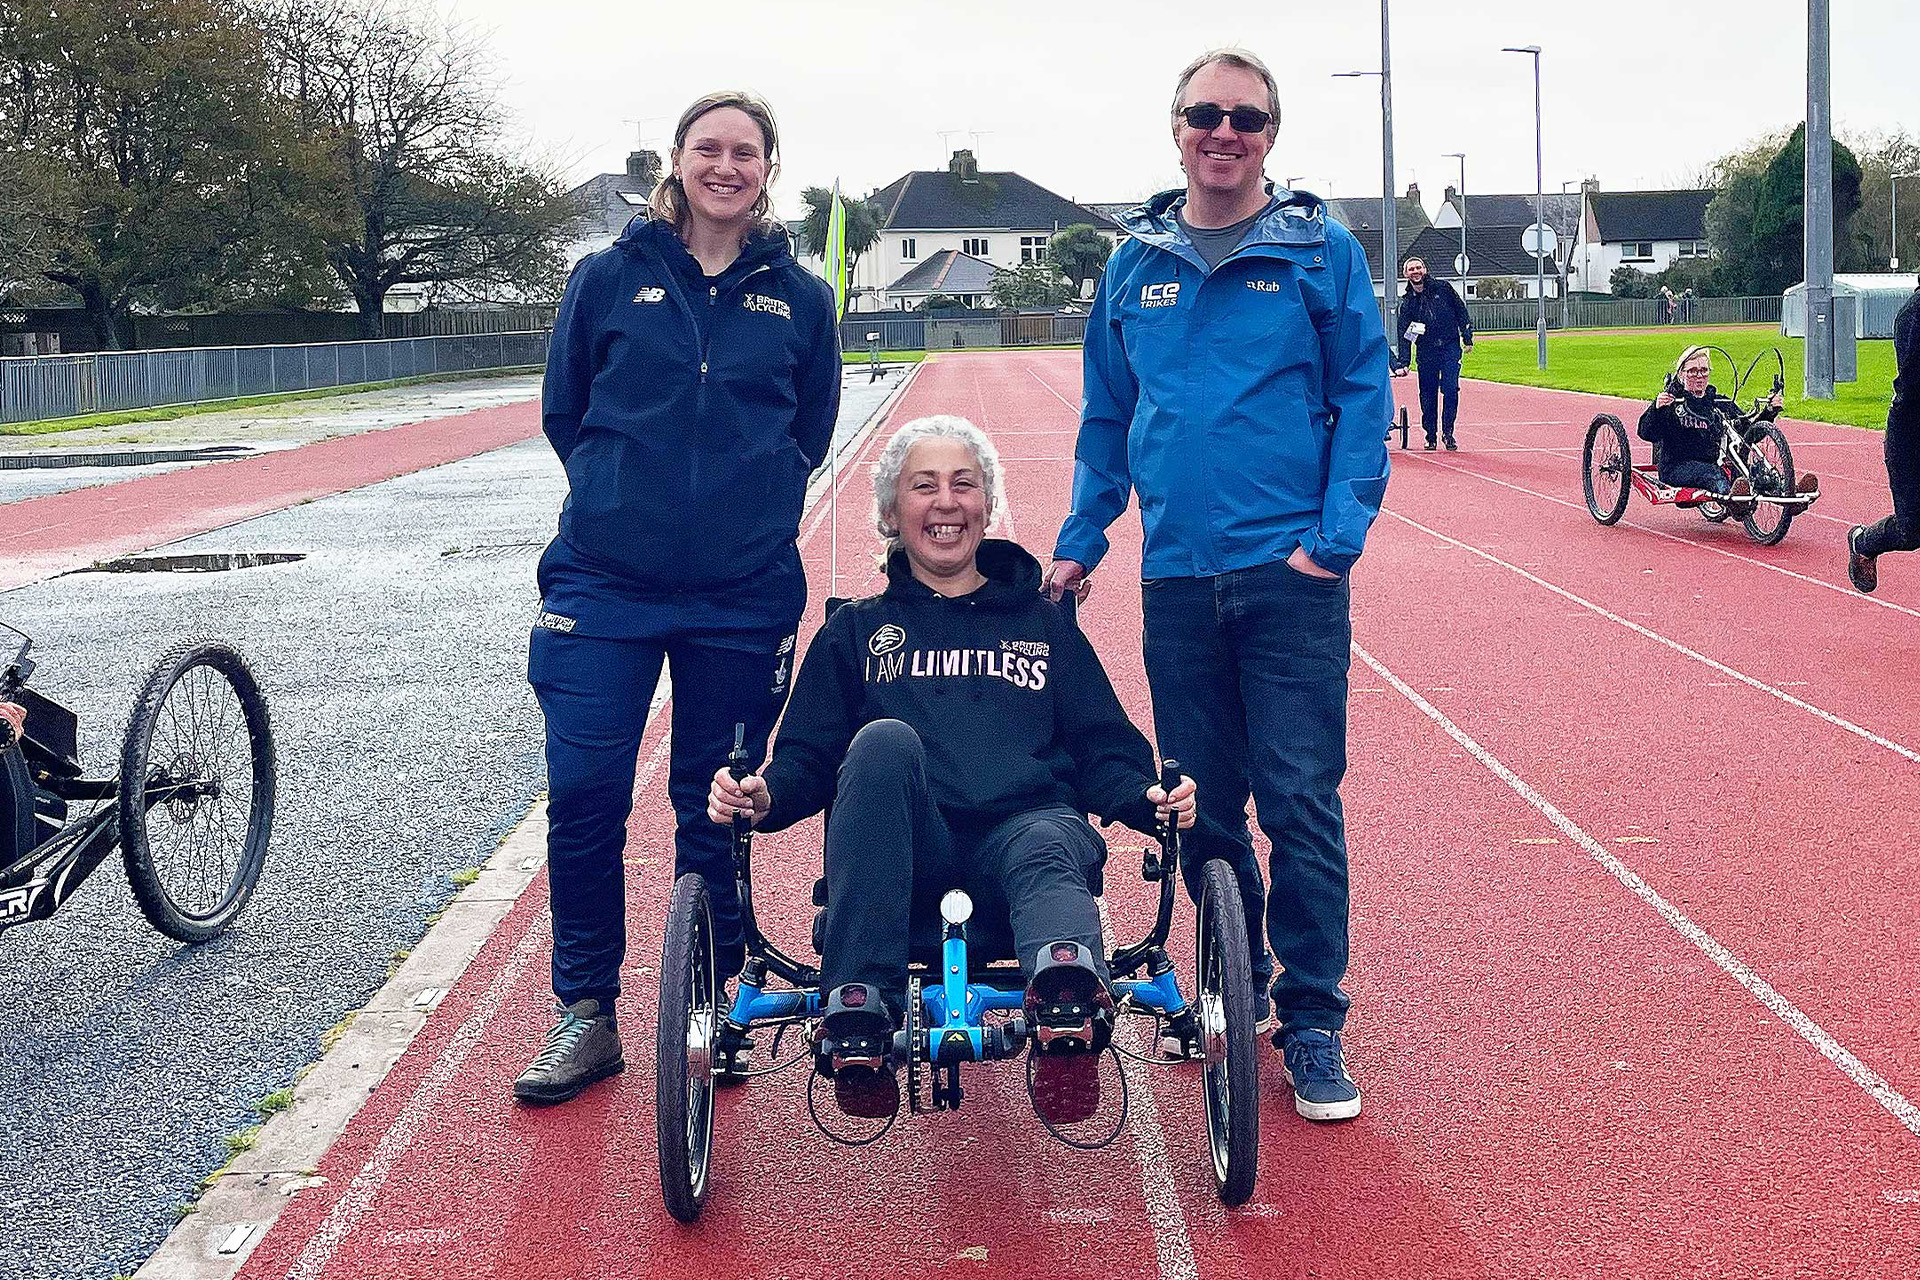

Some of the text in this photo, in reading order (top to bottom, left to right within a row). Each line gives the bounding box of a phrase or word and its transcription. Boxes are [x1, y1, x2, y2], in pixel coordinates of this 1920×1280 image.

[1140, 282, 1180, 301] ICE
[1256, 280, 1280, 292] Rab
[756, 295, 791, 314] BRITISH
[756, 303, 791, 320] CYCLING
[1140, 298, 1177, 309] TRIKES
[865, 649, 1049, 691] I AM LIMITLESS
